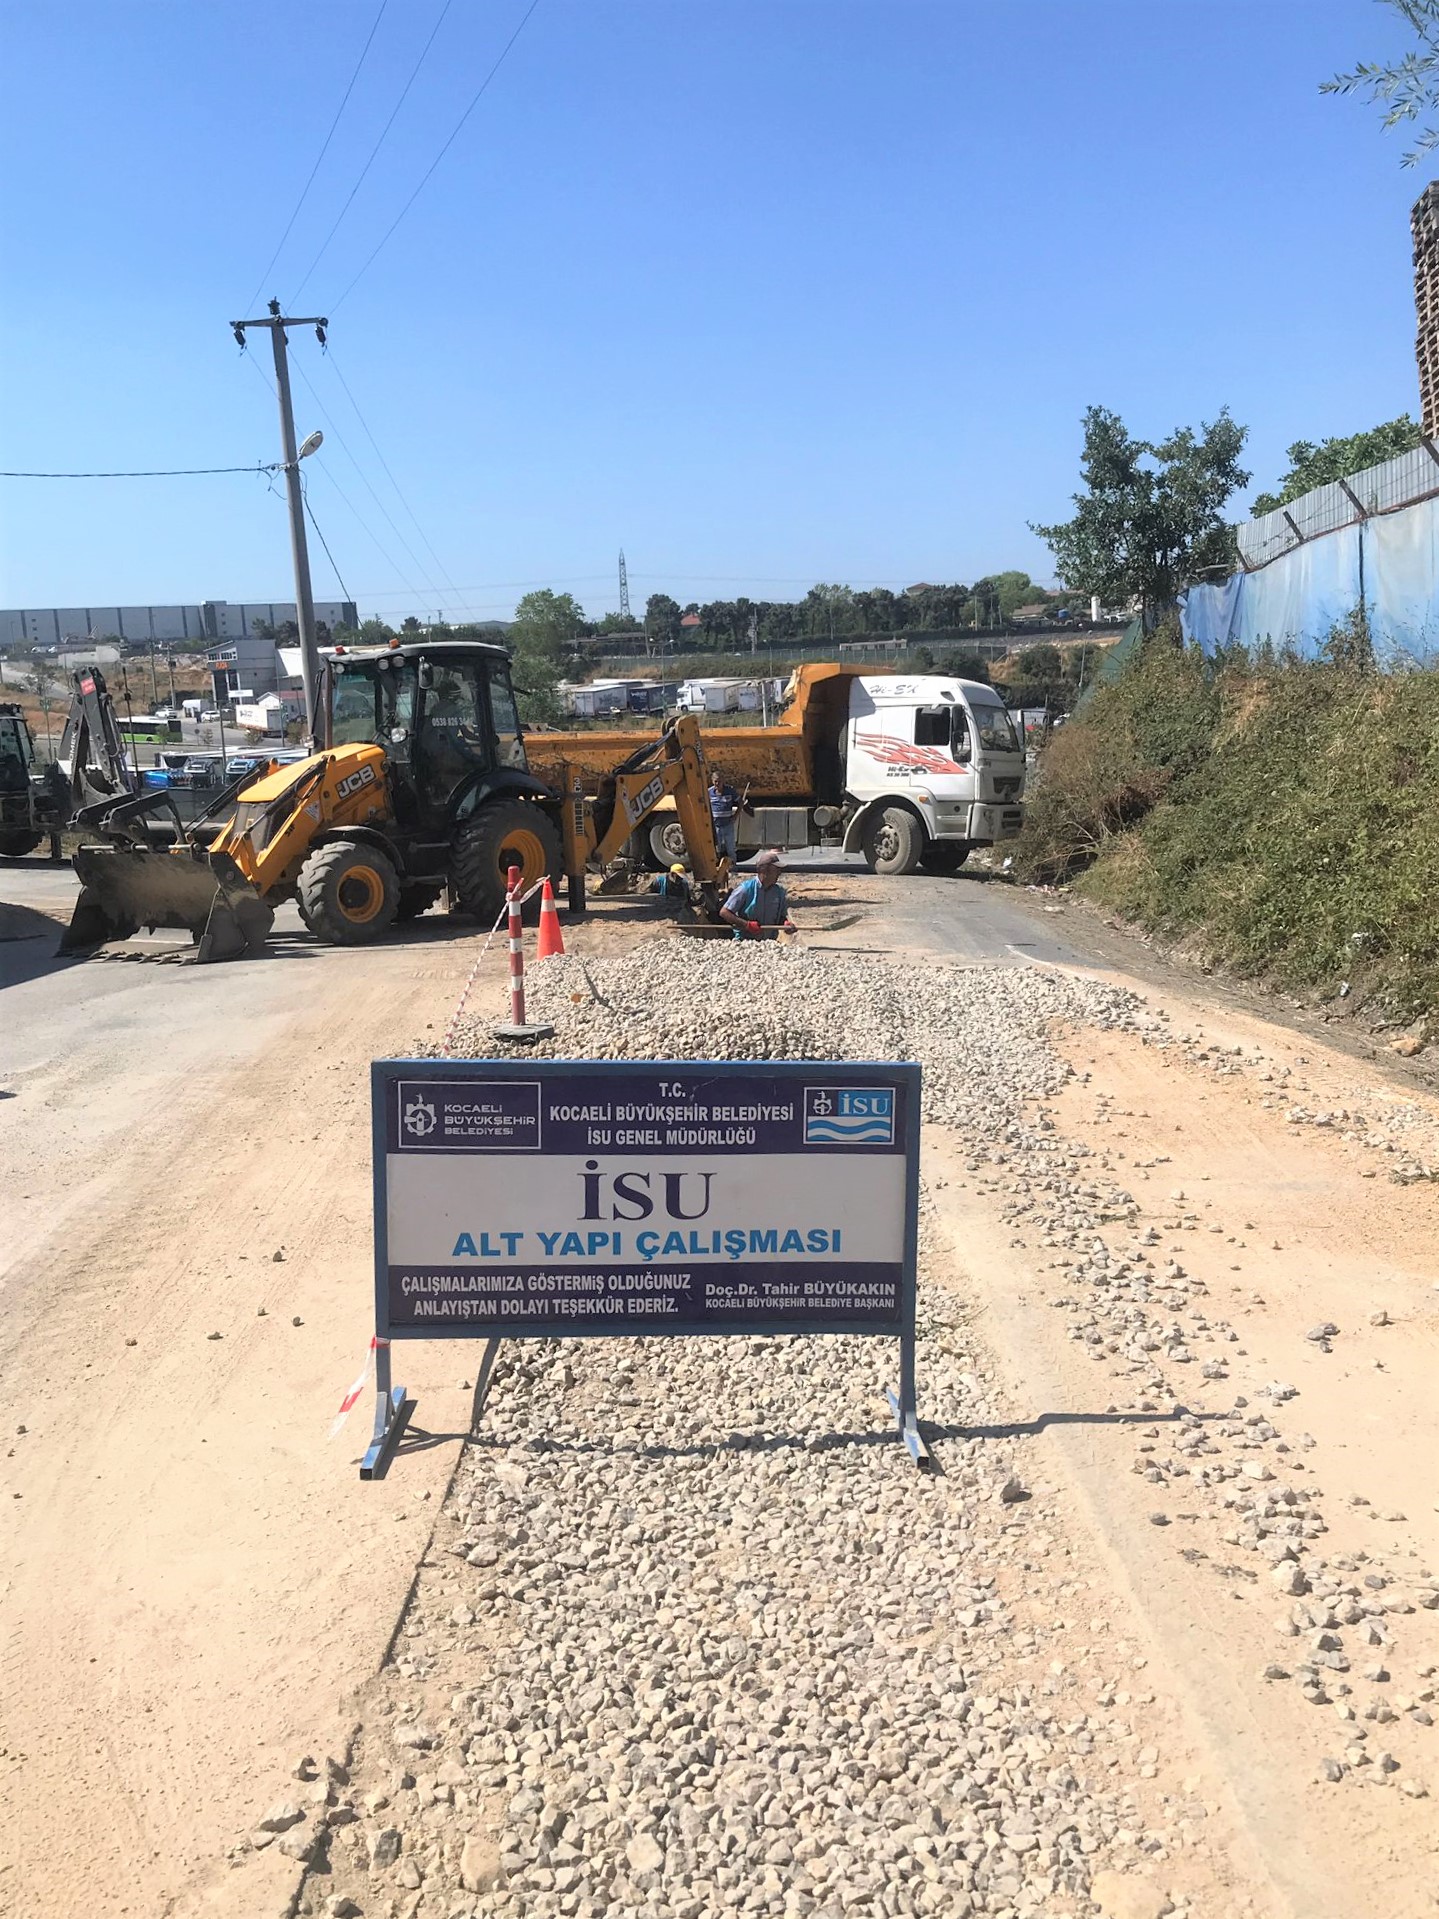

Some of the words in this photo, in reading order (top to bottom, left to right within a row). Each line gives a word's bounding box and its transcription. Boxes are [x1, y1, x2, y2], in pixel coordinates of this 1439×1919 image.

[68, 732, 78, 762] OMEK
[337, 765, 375, 798] JCB
[632, 776, 664, 817] JCB
[659, 1082, 686, 1098] T.C.
[550, 1103, 611, 1121] KOCAELİ
[615, 1103, 708, 1125] BÜYÜKŞEHİR
[712, 1103, 794, 1121] BELEDİYESİ
[842, 1093, 889, 1115] İSU
[587, 1127, 611, 1145] İSU
[615, 1129, 662, 1145] GENEL
[666, 1126, 756, 1145] MÜDÜRLÜĞÜ
[576, 1159, 718, 1221] İSU
[452, 1232, 523, 1257] ALT
[536, 1232, 621, 1256] YAPI
[636, 1229, 841, 1261] ÇALIŞMASI
[402, 1275, 525, 1296] ÇALIŞMALARIMIZA
[608, 1271, 691, 1291] OLDUĞUNUZ
[763, 1283, 800, 1295] Tahir
[804, 1281, 896, 1295] BÜYÜKAKIN
[414, 1299, 498, 1319] ANLAYIŞTAN
[501, 1298, 549, 1315] DOLAYI
[552, 1295, 624, 1318] TEŞEKKÜR
[628, 1294, 679, 1313] EDERİZ.
[854, 1299, 894, 1310] BAŞKANI
